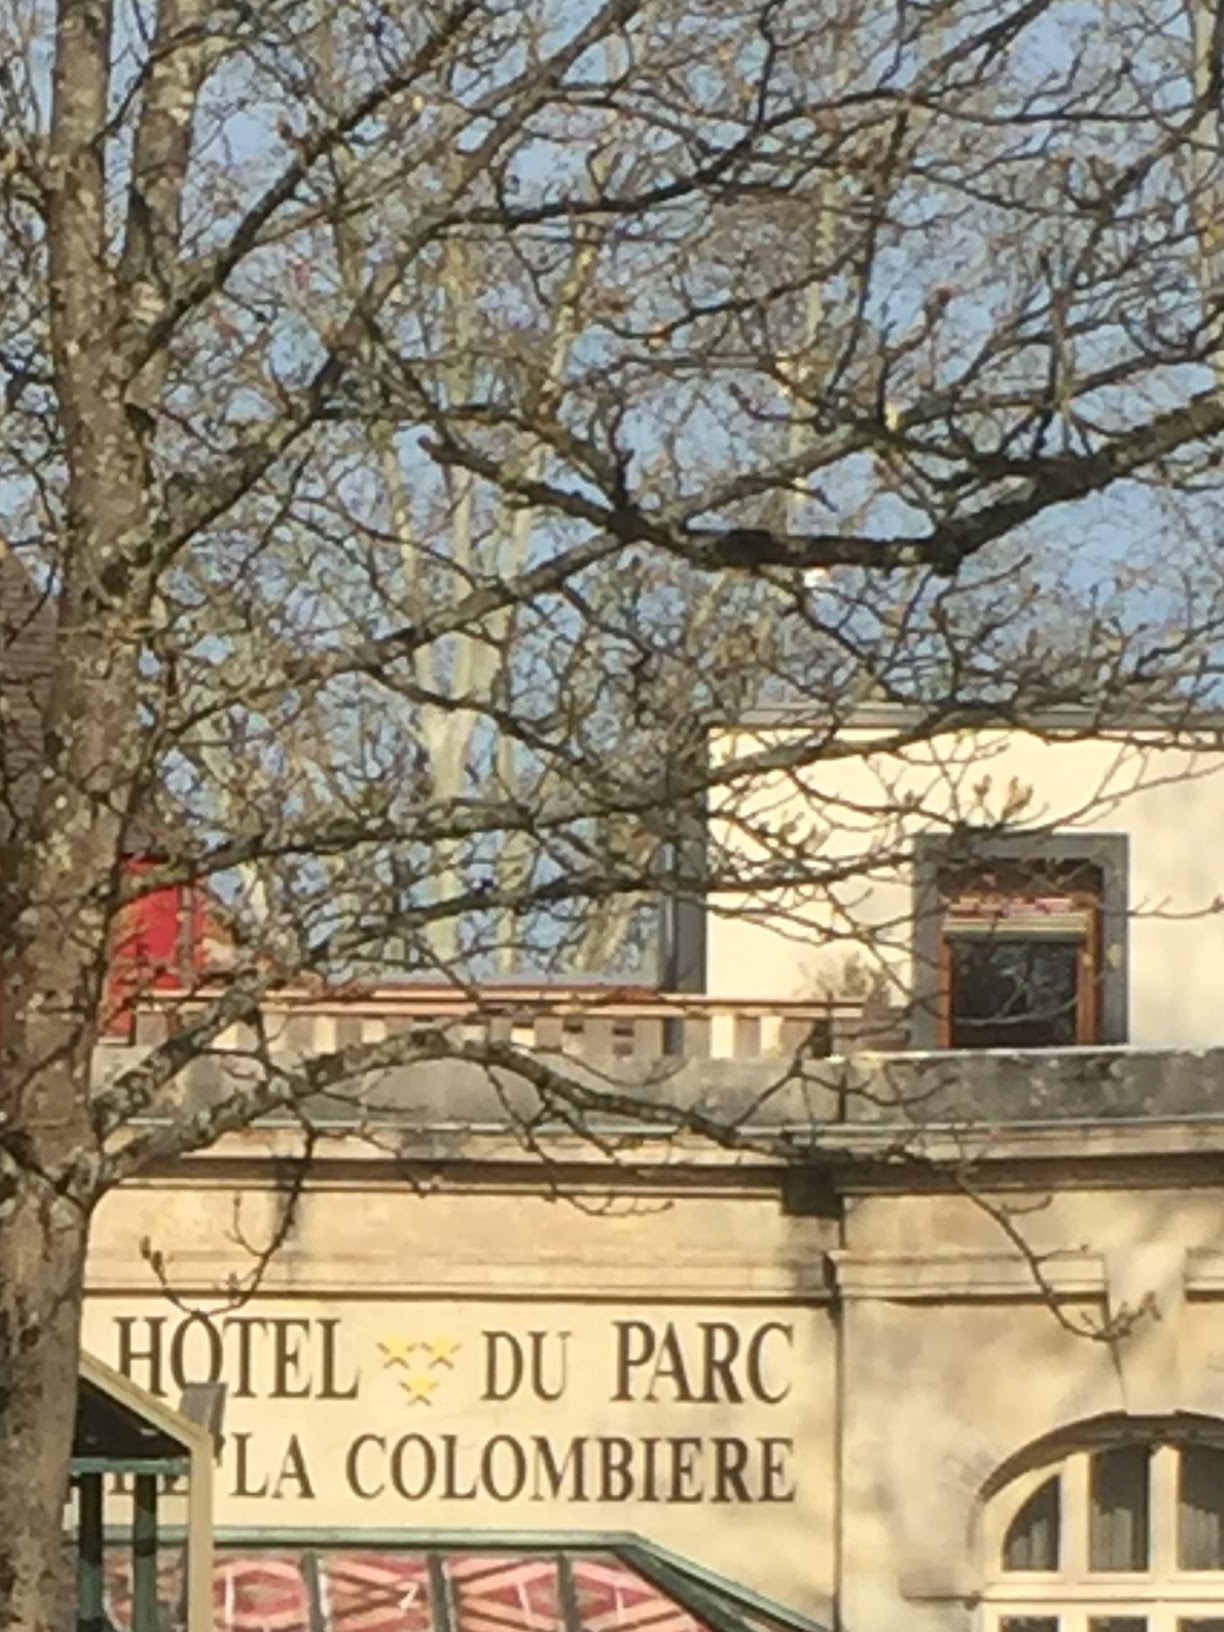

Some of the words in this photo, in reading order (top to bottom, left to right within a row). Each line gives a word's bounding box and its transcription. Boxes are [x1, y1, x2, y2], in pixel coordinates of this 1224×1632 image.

[480, 1330, 572, 1401] DU
[609, 1320, 795, 1403] PARC
[230, 1432, 316, 1499] LA
[345, 1433, 797, 1503] COLOMBIERE
